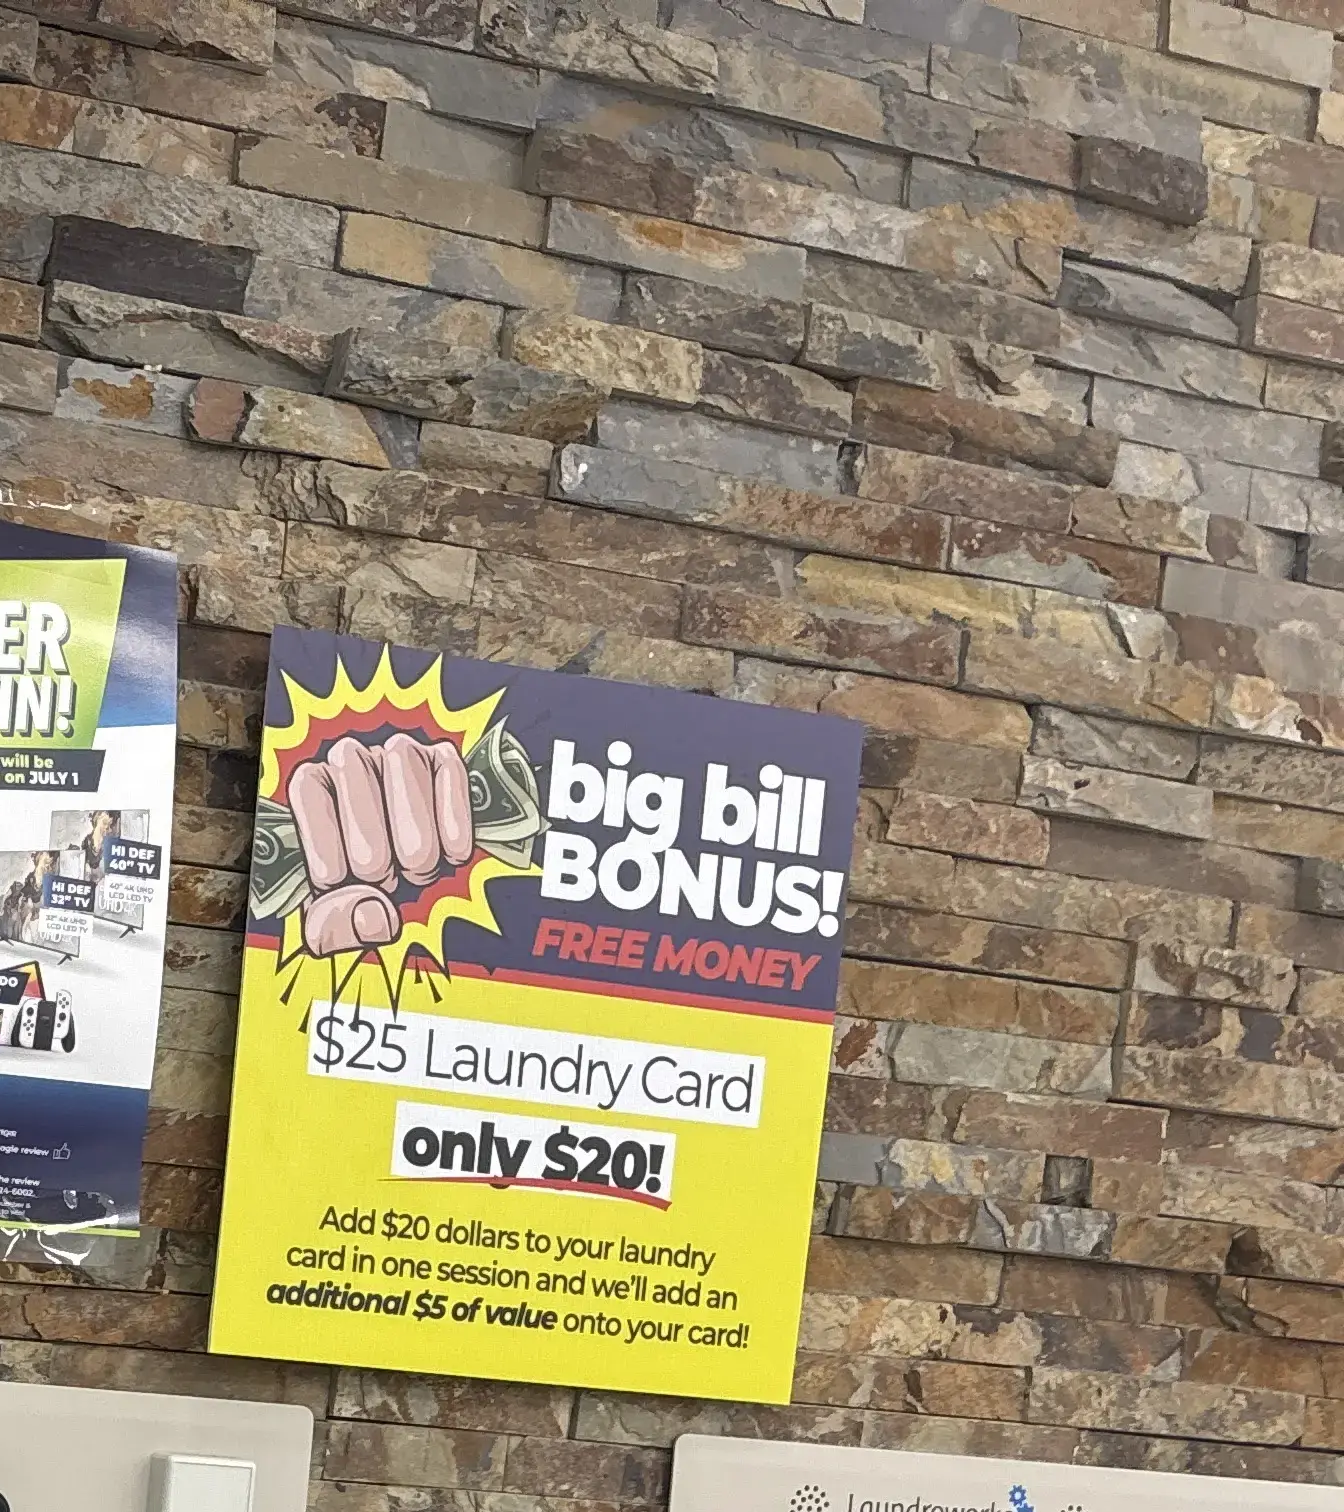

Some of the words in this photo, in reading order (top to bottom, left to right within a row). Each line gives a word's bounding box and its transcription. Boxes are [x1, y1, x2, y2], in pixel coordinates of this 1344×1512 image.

[547, 739, 683, 852] big
[701, 763, 826, 857] bill
[541, 832, 845, 939] BONUS!
[532, 918, 645, 970] FREE
[653, 938, 822, 992] MONEY
[312, 1015, 408, 1074] $25
[425, 1028, 633, 1111] Laundry
[641, 1055, 755, 1114] Card
[402, 1121, 531, 1190] only
[542, 1125, 664, 1194] $20!
